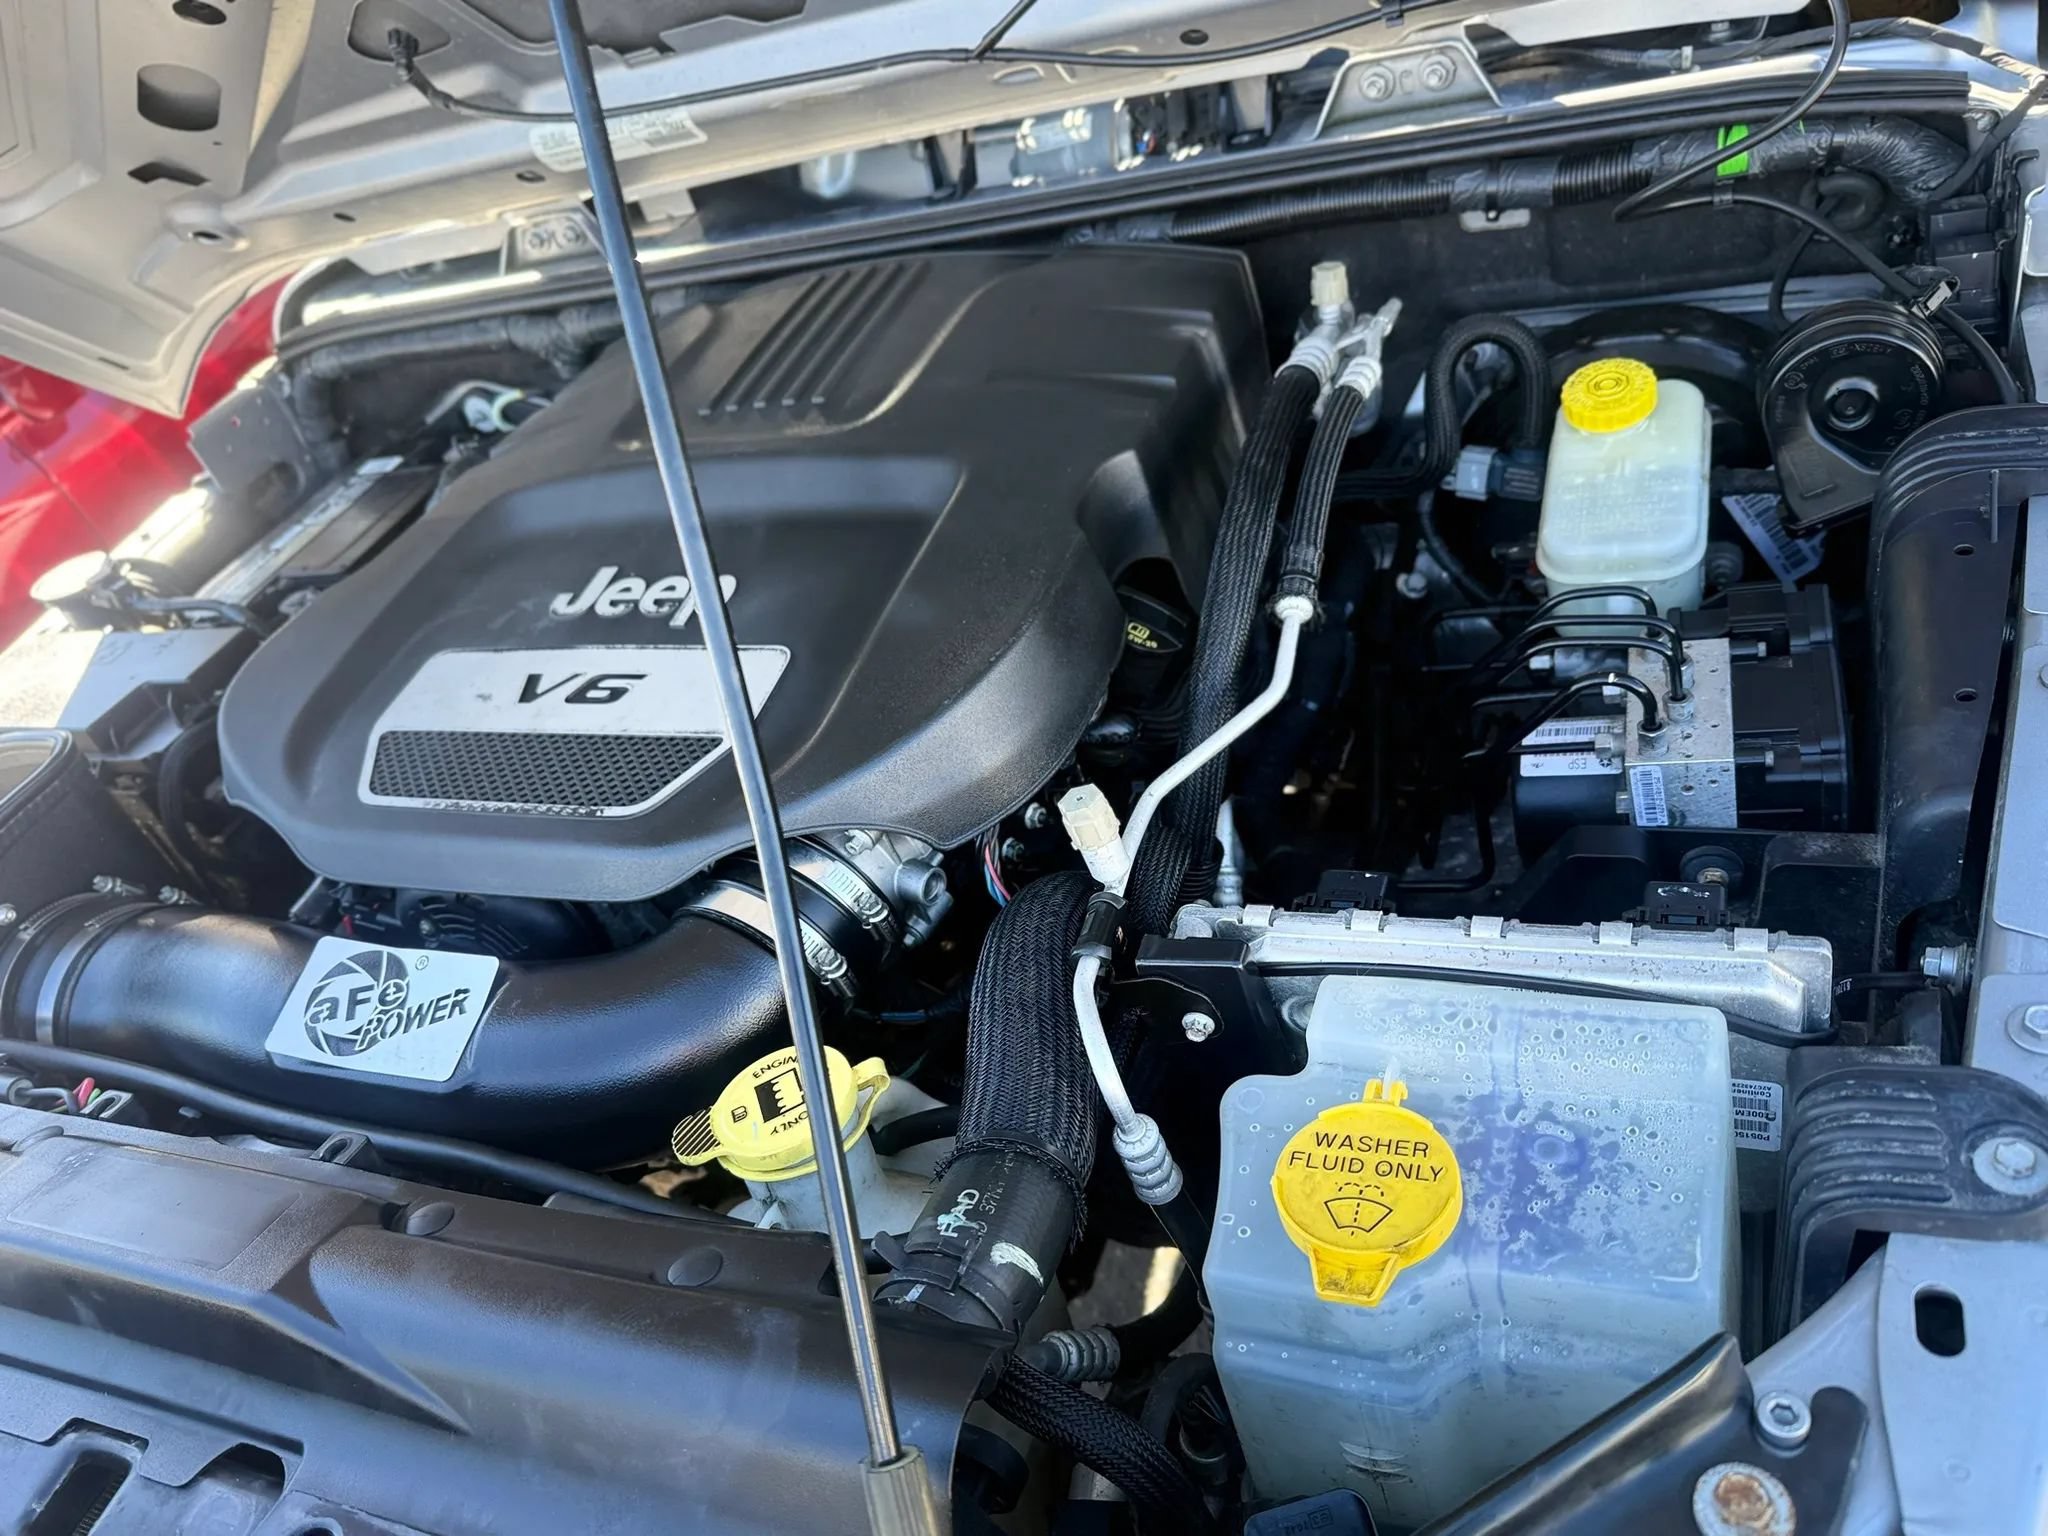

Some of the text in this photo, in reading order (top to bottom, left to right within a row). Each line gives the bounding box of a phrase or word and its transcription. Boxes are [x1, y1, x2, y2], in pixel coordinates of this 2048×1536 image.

[518, 673, 648, 704] V6
[1568, 758, 1587, 770] ESP
[356, 988, 471, 1050] POWER
[752, 1055, 799, 1079] ENGIN
[770, 1110, 809, 1136] ONLY
[1315, 1131, 1429, 1158] WASHER
[1289, 1150, 1445, 1182] FLUID ONLY
